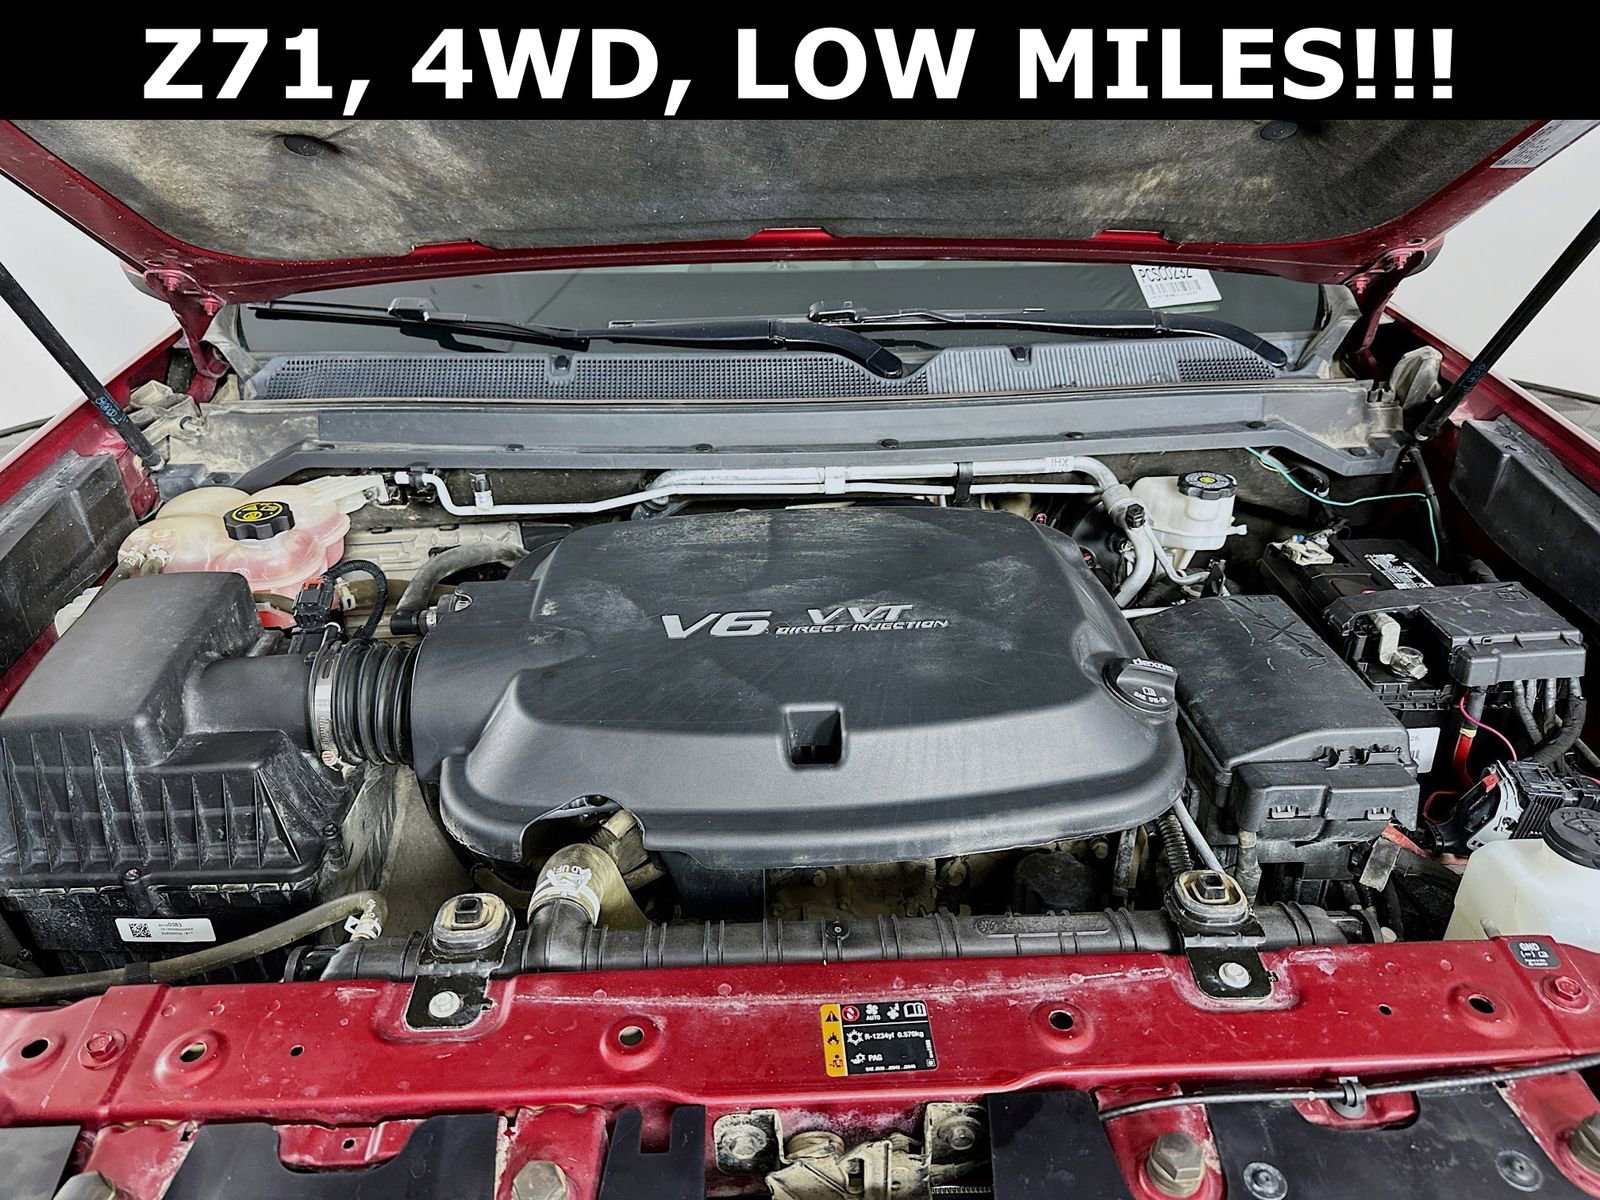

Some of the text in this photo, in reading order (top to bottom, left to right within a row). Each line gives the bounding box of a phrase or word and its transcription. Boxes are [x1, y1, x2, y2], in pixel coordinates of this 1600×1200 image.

[661, 605, 914, 639] V6 VVT
[775, 620, 948, 635] DIRECT INJECTION
